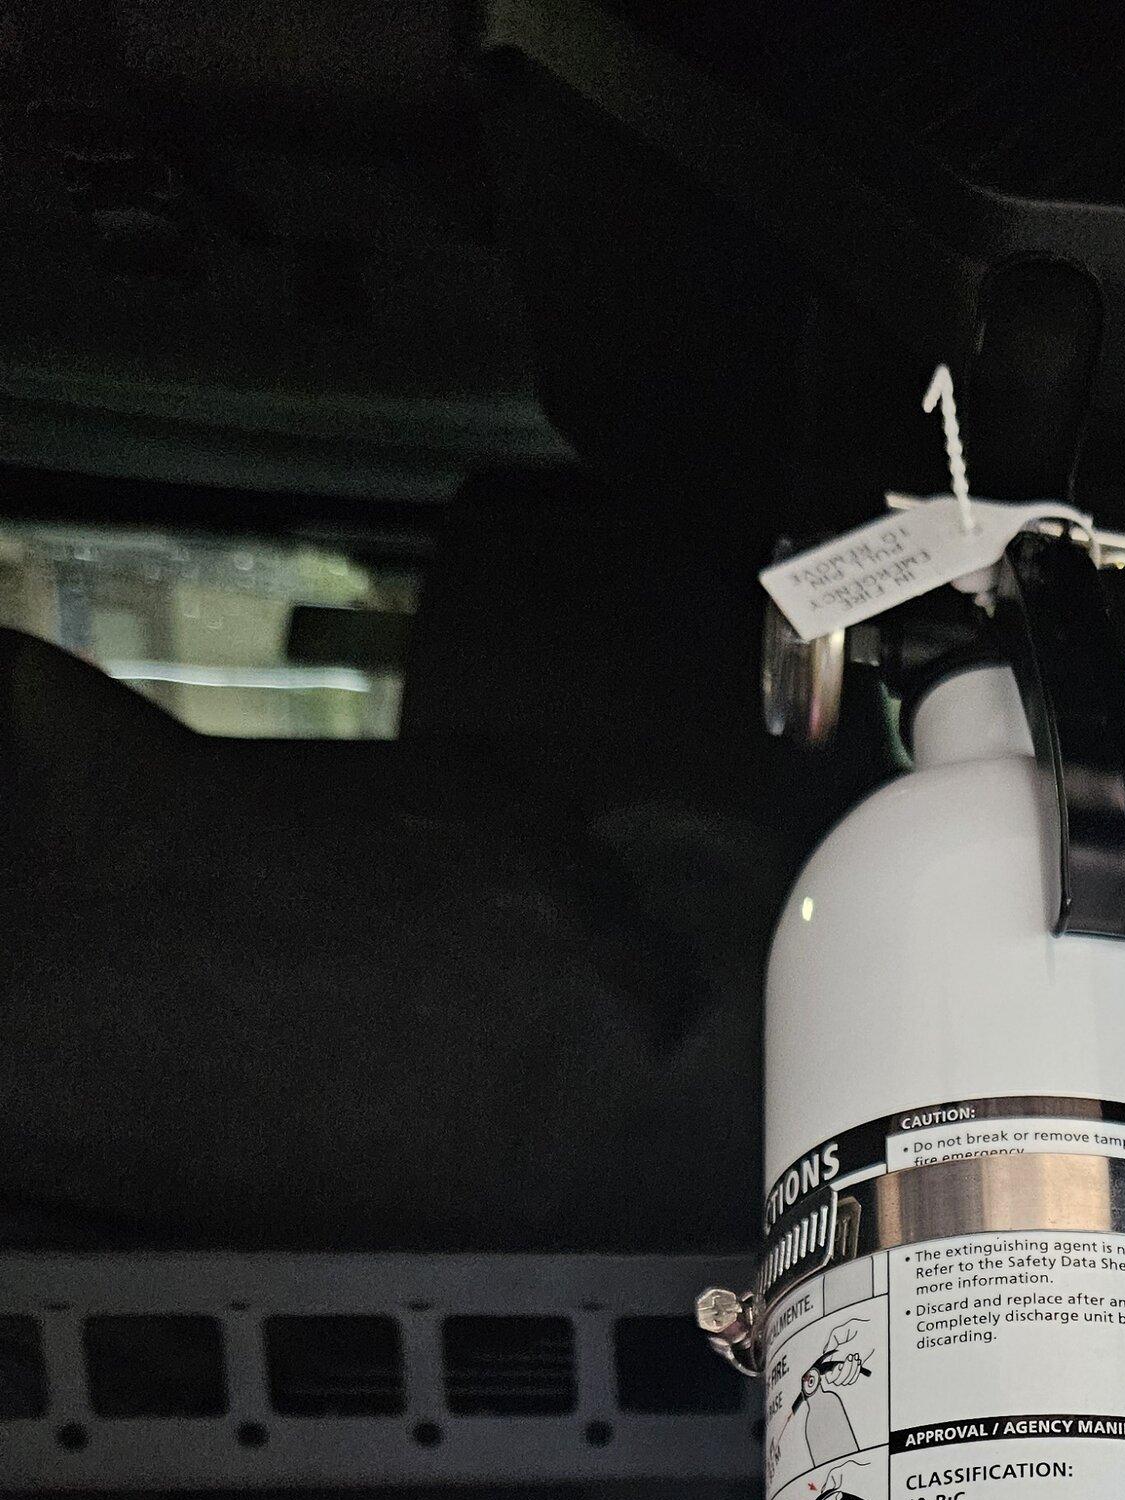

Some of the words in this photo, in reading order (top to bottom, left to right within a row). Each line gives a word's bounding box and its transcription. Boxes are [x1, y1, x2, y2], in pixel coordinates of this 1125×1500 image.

[900, 1106, 980, 1134] CAUTION:
[913, 1141, 934, 1154] Do
[936, 1135, 963, 1149] not
[965, 1129, 1009, 1145] break
[1012, 1131, 1030, 1142] or
[1033, 1131, 1090, 1144] remove
[914, 1249, 942, 1263] The
[945, 1238, 1049, 1258] extinguishing
[1053, 1241, 1098, 1255] agent
[1101, 1240, 1113, 1255] is
[915, 1262, 955, 1280] Refer
[957, 1261, 975, 1273] to
[977, 1256, 1004, 1271] the
[1007, 1254, 1057, 1271] Safety
[1060, 1254, 1097, 1269] Data
[915, 1280, 954, 1296] more
[957, 1271, 1054, 1290] information.
[915, 1296, 969, 1317] Discard
[972, 1293, 1002, 1309] and
[1006, 1292, 1064, 1308] replace
[1067, 1291, 1106, 1307] after
[915, 1310, 1001, 1334] Completely
[1004, 1308, 1080, 1325] discharge
[1083, 1310, 1115, 1324] unit
[915, 1329, 998, 1350] discarding.
[904, 1423, 989, 1448] APPROVAL
[1002, 1419, 1074, 1435] AGENCY
[905, 1461, 1074, 1491] CLASSIFICATION:
